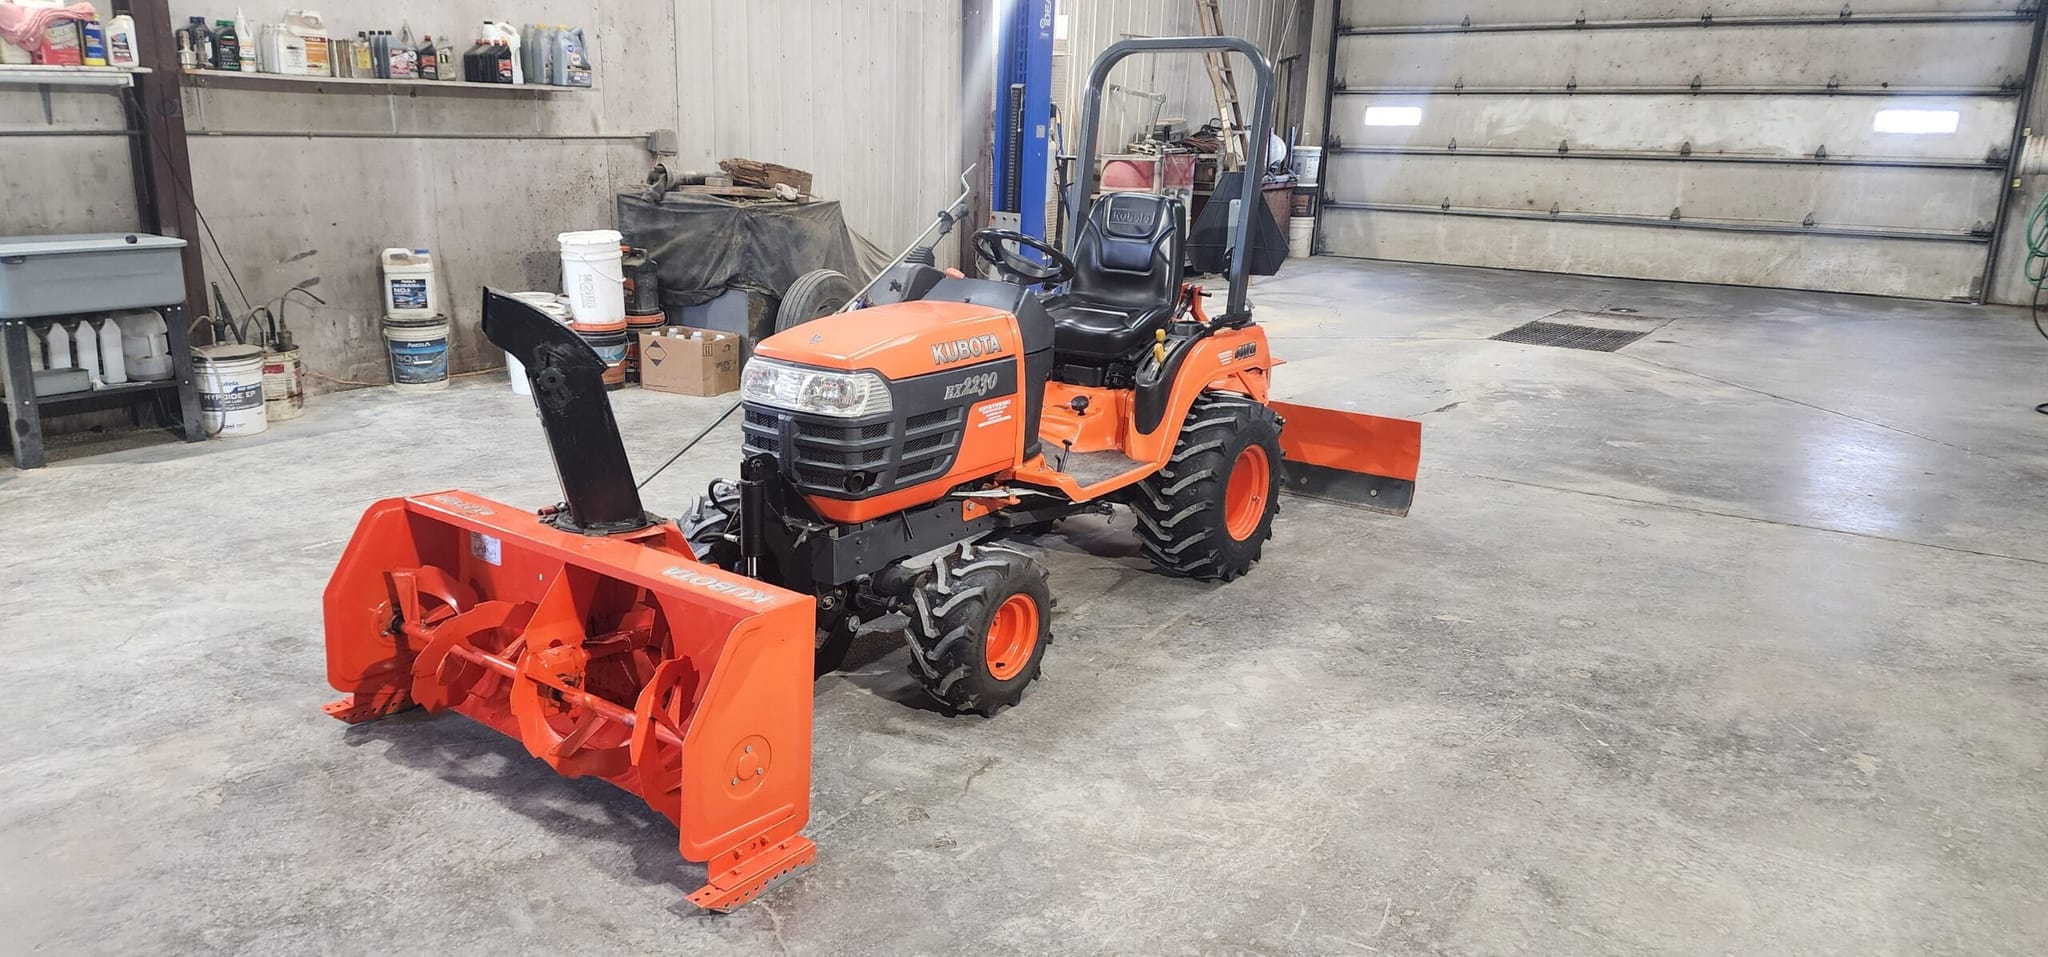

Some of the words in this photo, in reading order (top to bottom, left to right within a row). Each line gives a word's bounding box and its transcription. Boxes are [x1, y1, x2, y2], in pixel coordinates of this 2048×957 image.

[931, 333, 1002, 365] KUBOTA
[944, 371, 998, 400] BX2230
[663, 567, 776, 603] KUBOTA
